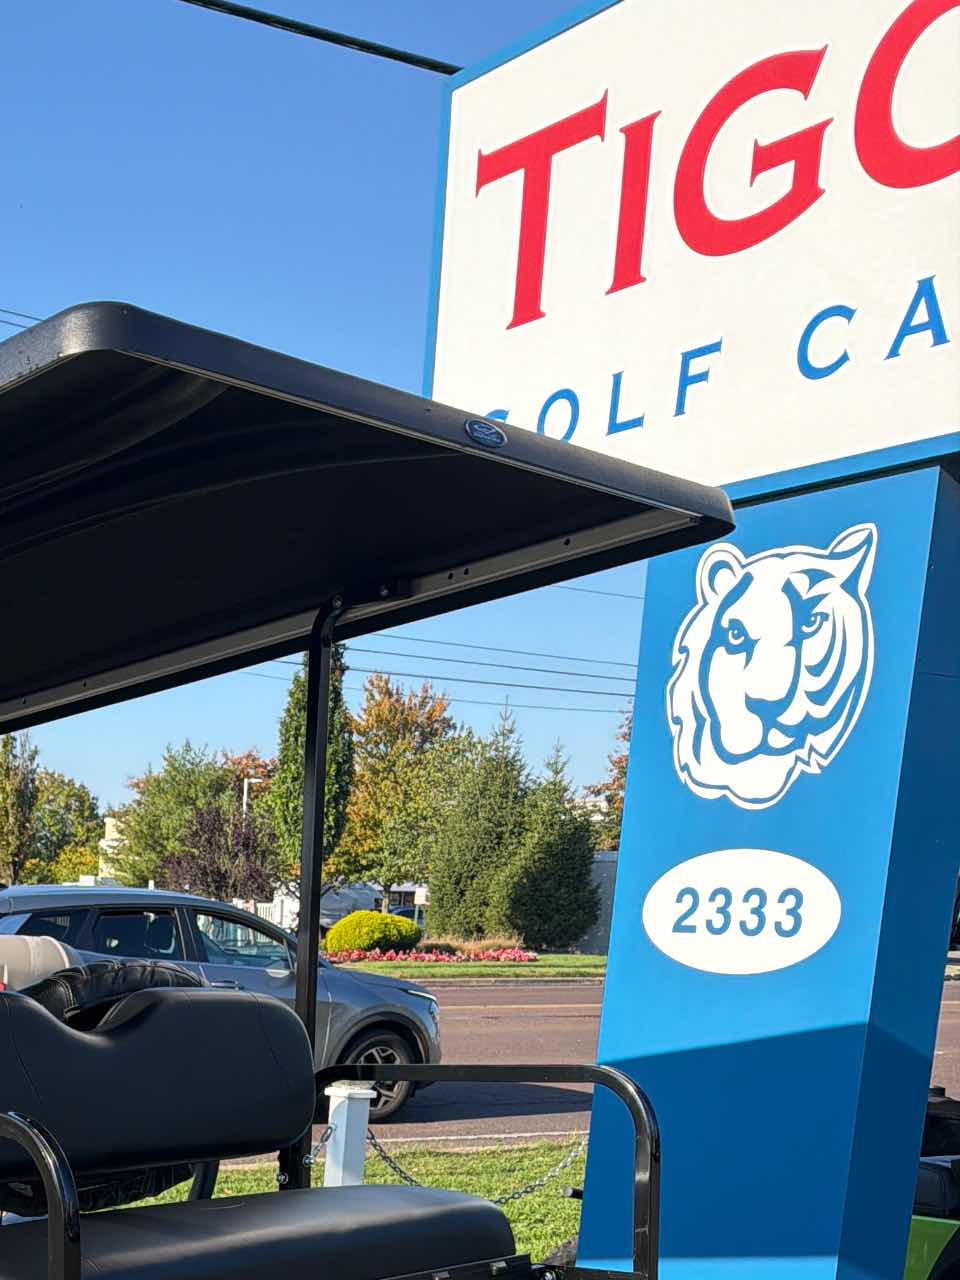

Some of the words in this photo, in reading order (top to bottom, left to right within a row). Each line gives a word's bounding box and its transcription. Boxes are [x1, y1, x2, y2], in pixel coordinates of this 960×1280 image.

[484, 341, 723, 444] OLF
[797, 275, 950, 381] CA
[671, 887, 804, 938] 2333
